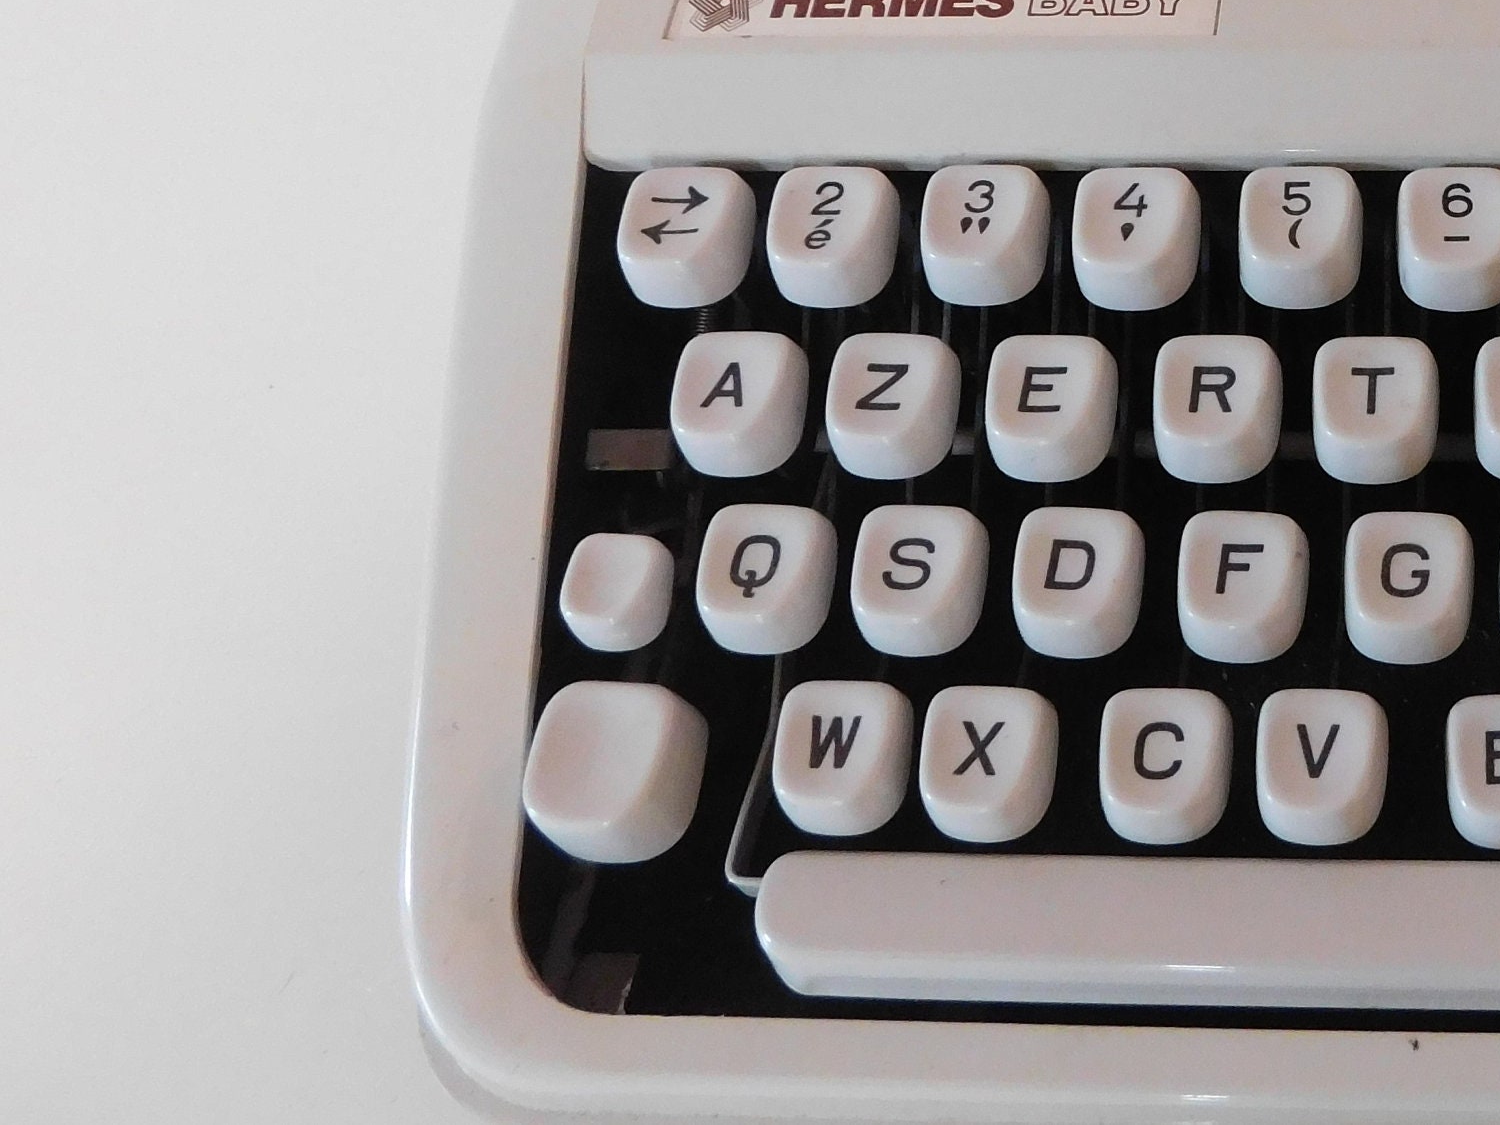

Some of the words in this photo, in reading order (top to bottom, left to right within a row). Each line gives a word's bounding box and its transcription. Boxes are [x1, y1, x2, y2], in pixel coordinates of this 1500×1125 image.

[811, 181, 843, 216] 2
[964, 180, 995, 214] 3
[1113, 182, 1149, 216] 4
[1282, 181, 1312, 216] 5
[1442, 183, 1473, 216] 6
[803, 218, 833, 249] é
[700, 362, 744, 408] A
[855, 363, 910, 411] Z
[1017, 366, 1068, 413] E
[1189, 366, 1237, 413] R
[1351, 367, 1395, 415] T
[730, 535, 781, 598] Q
[882, 538, 936, 591] S
[1044, 539, 1096, 591] D
[1216, 544, 1265, 595] F
[1380, 543, 1431, 598] G
[809, 715, 862, 770] W
[952, 721, 1005, 776] X
[1133, 722, 1185, 780] C
[1297, 724, 1341, 779] V
